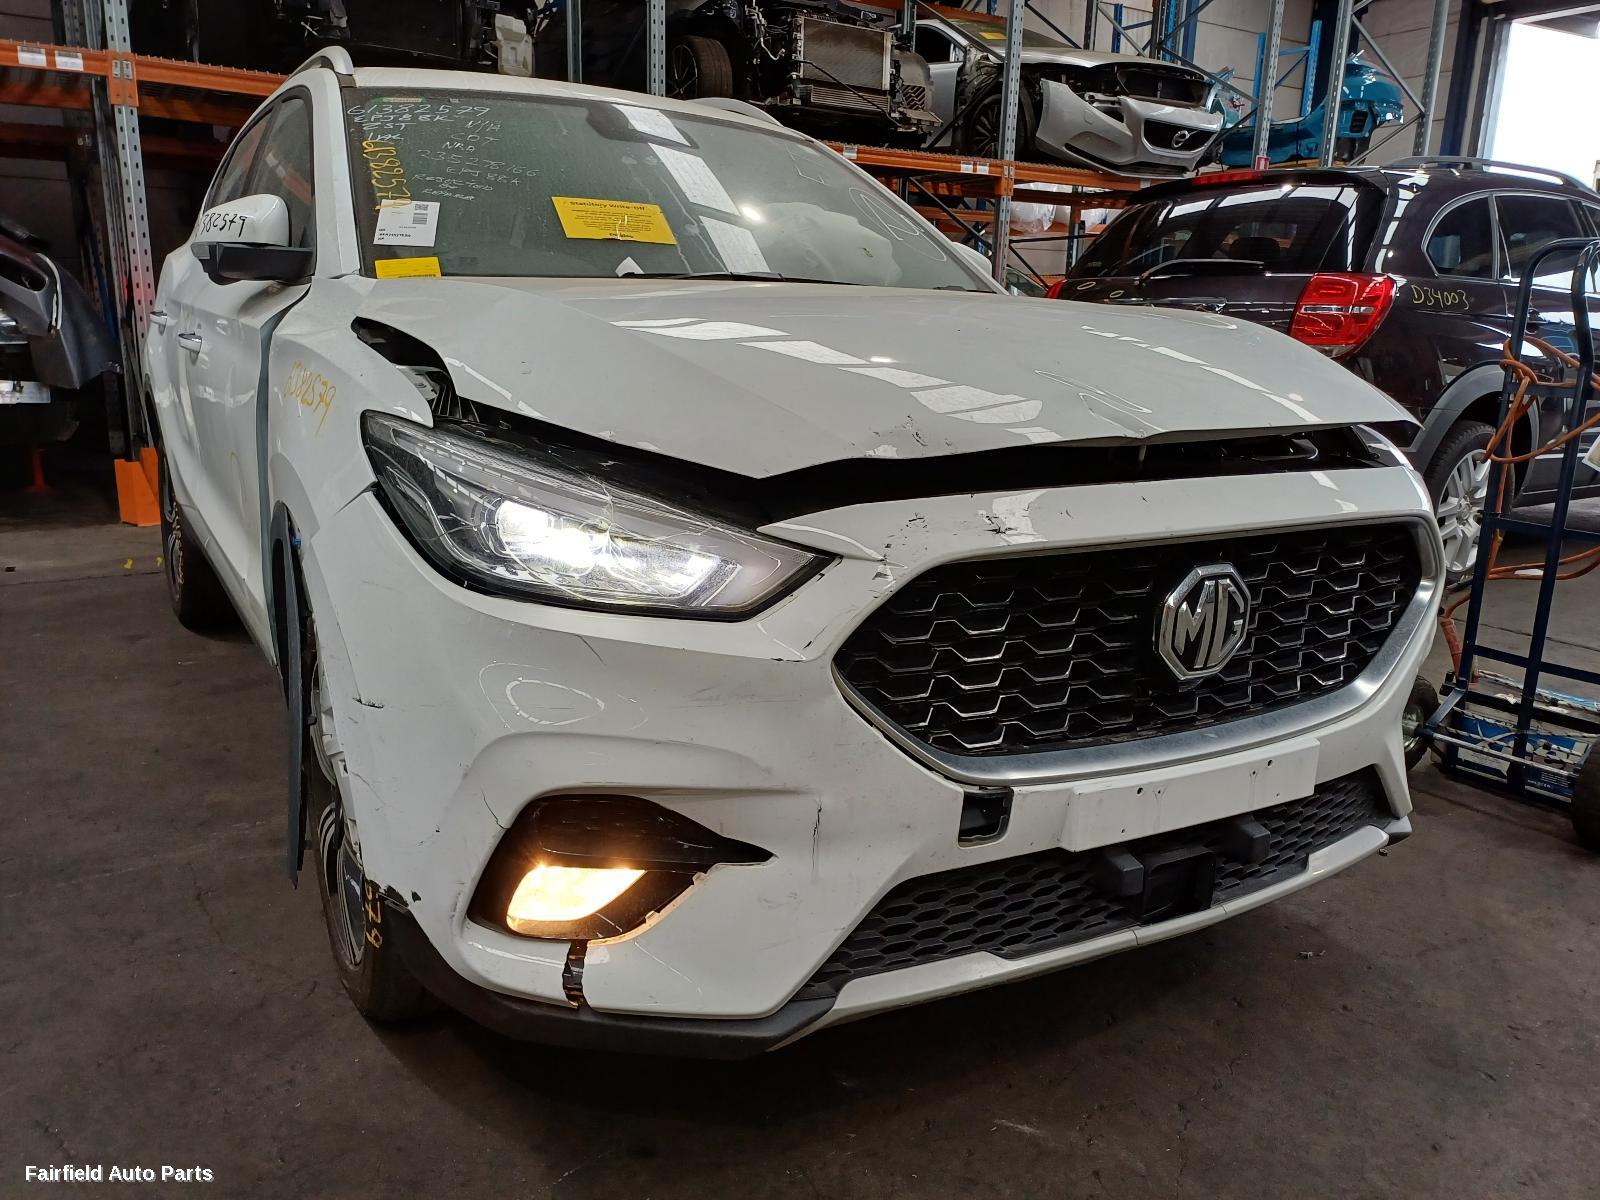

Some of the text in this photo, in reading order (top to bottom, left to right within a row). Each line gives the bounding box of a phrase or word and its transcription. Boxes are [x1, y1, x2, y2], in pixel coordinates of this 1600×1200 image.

[347, 104, 490, 117] 61382579
[1411, 285, 1470, 310] D34003
[1174, 578, 1245, 669] MG
